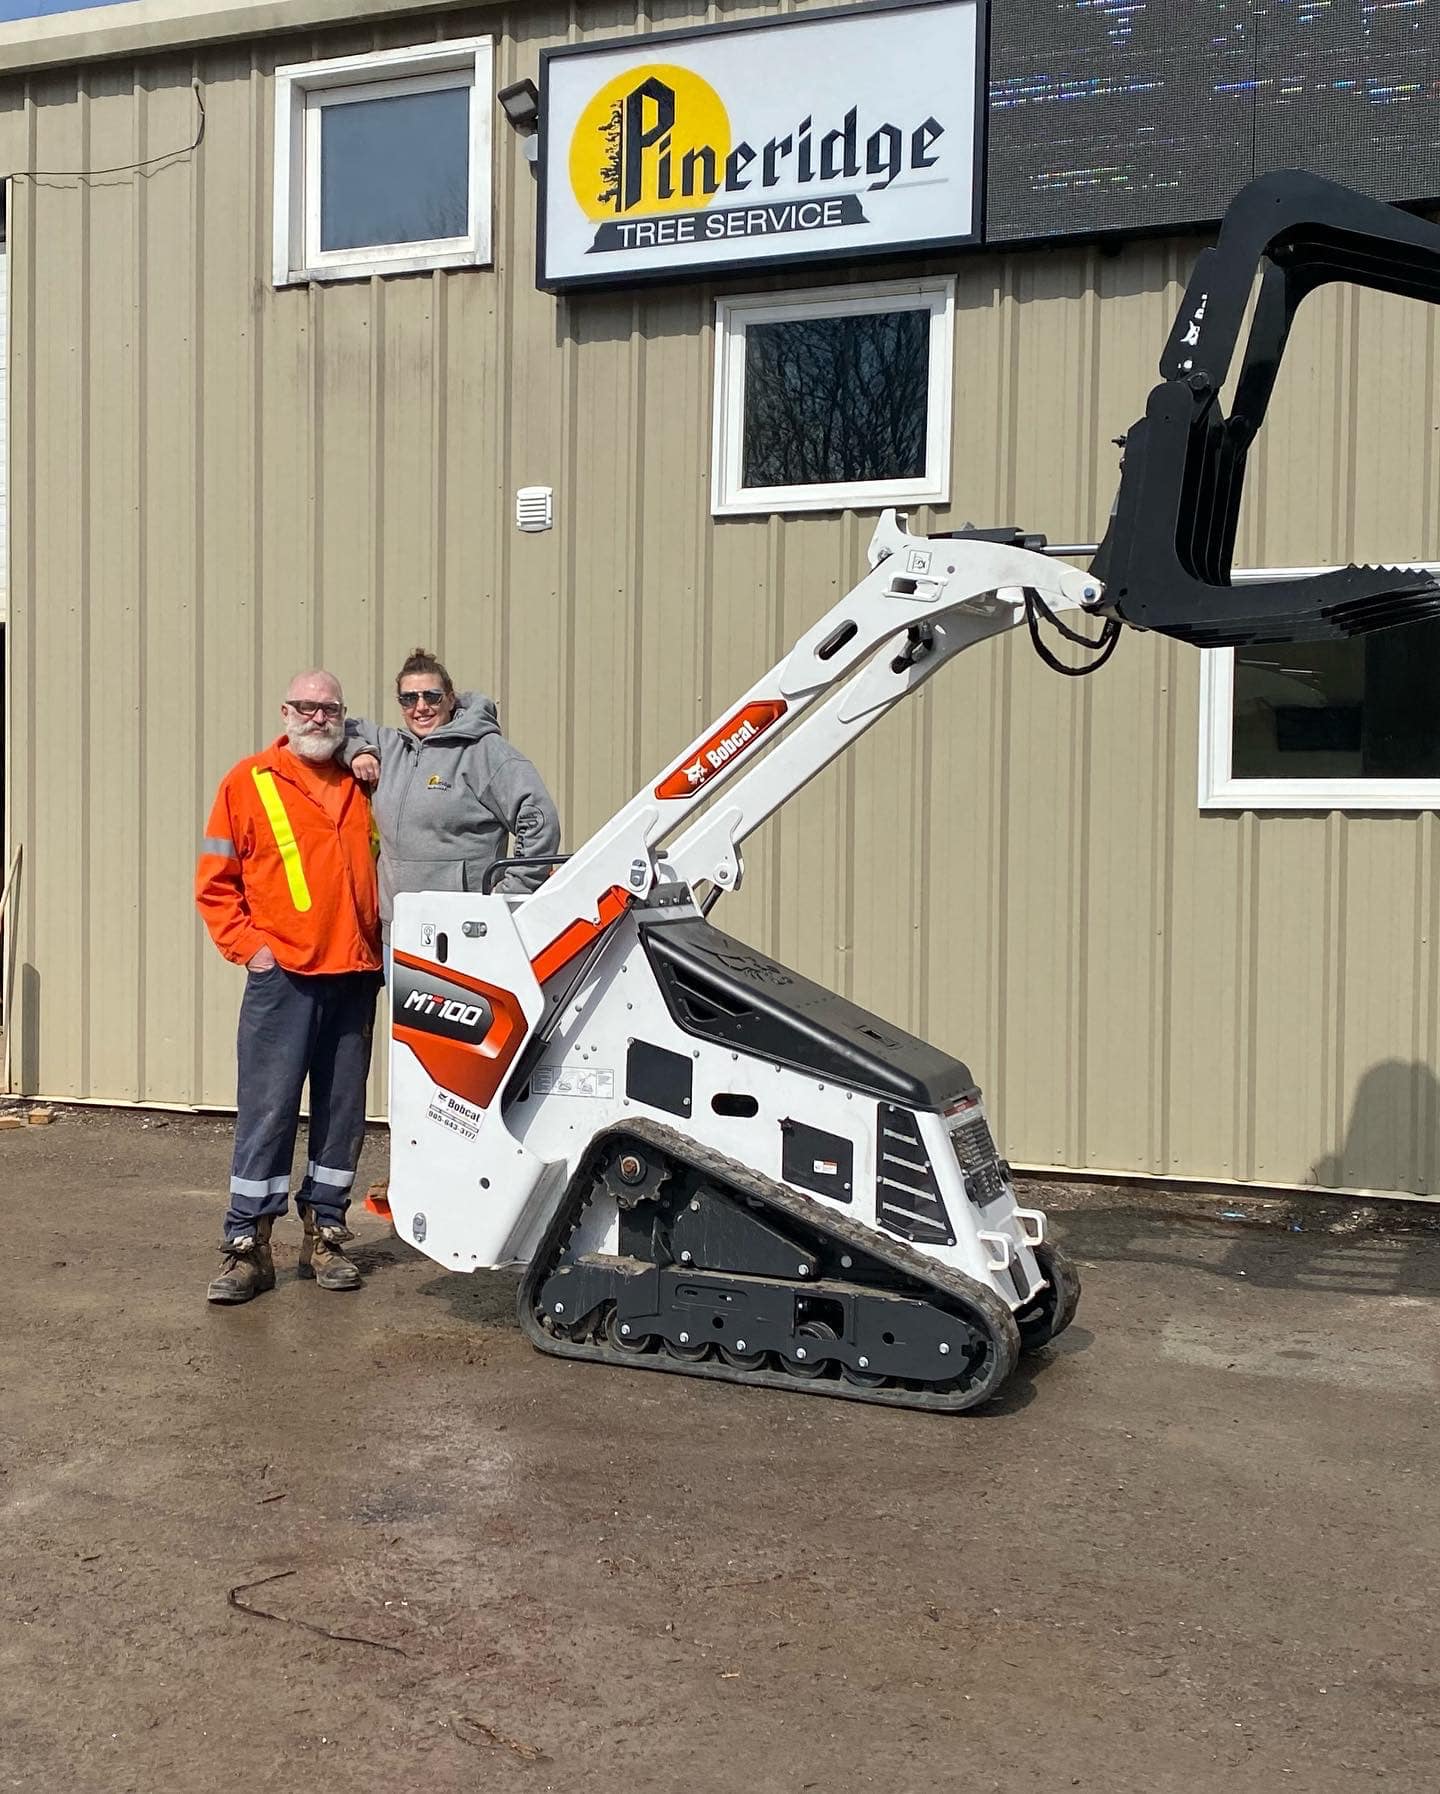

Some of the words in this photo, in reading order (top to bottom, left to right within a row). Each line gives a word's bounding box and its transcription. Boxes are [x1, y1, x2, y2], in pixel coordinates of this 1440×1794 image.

[623, 76, 945, 212] Pineridge
[617, 217, 696, 248] TREE
[705, 200, 843, 238] SERVICE
[705, 719, 757, 769] Bobcat
[403, 990, 483, 1027] MT100
[447, 1098, 481, 1123] Bobcat
